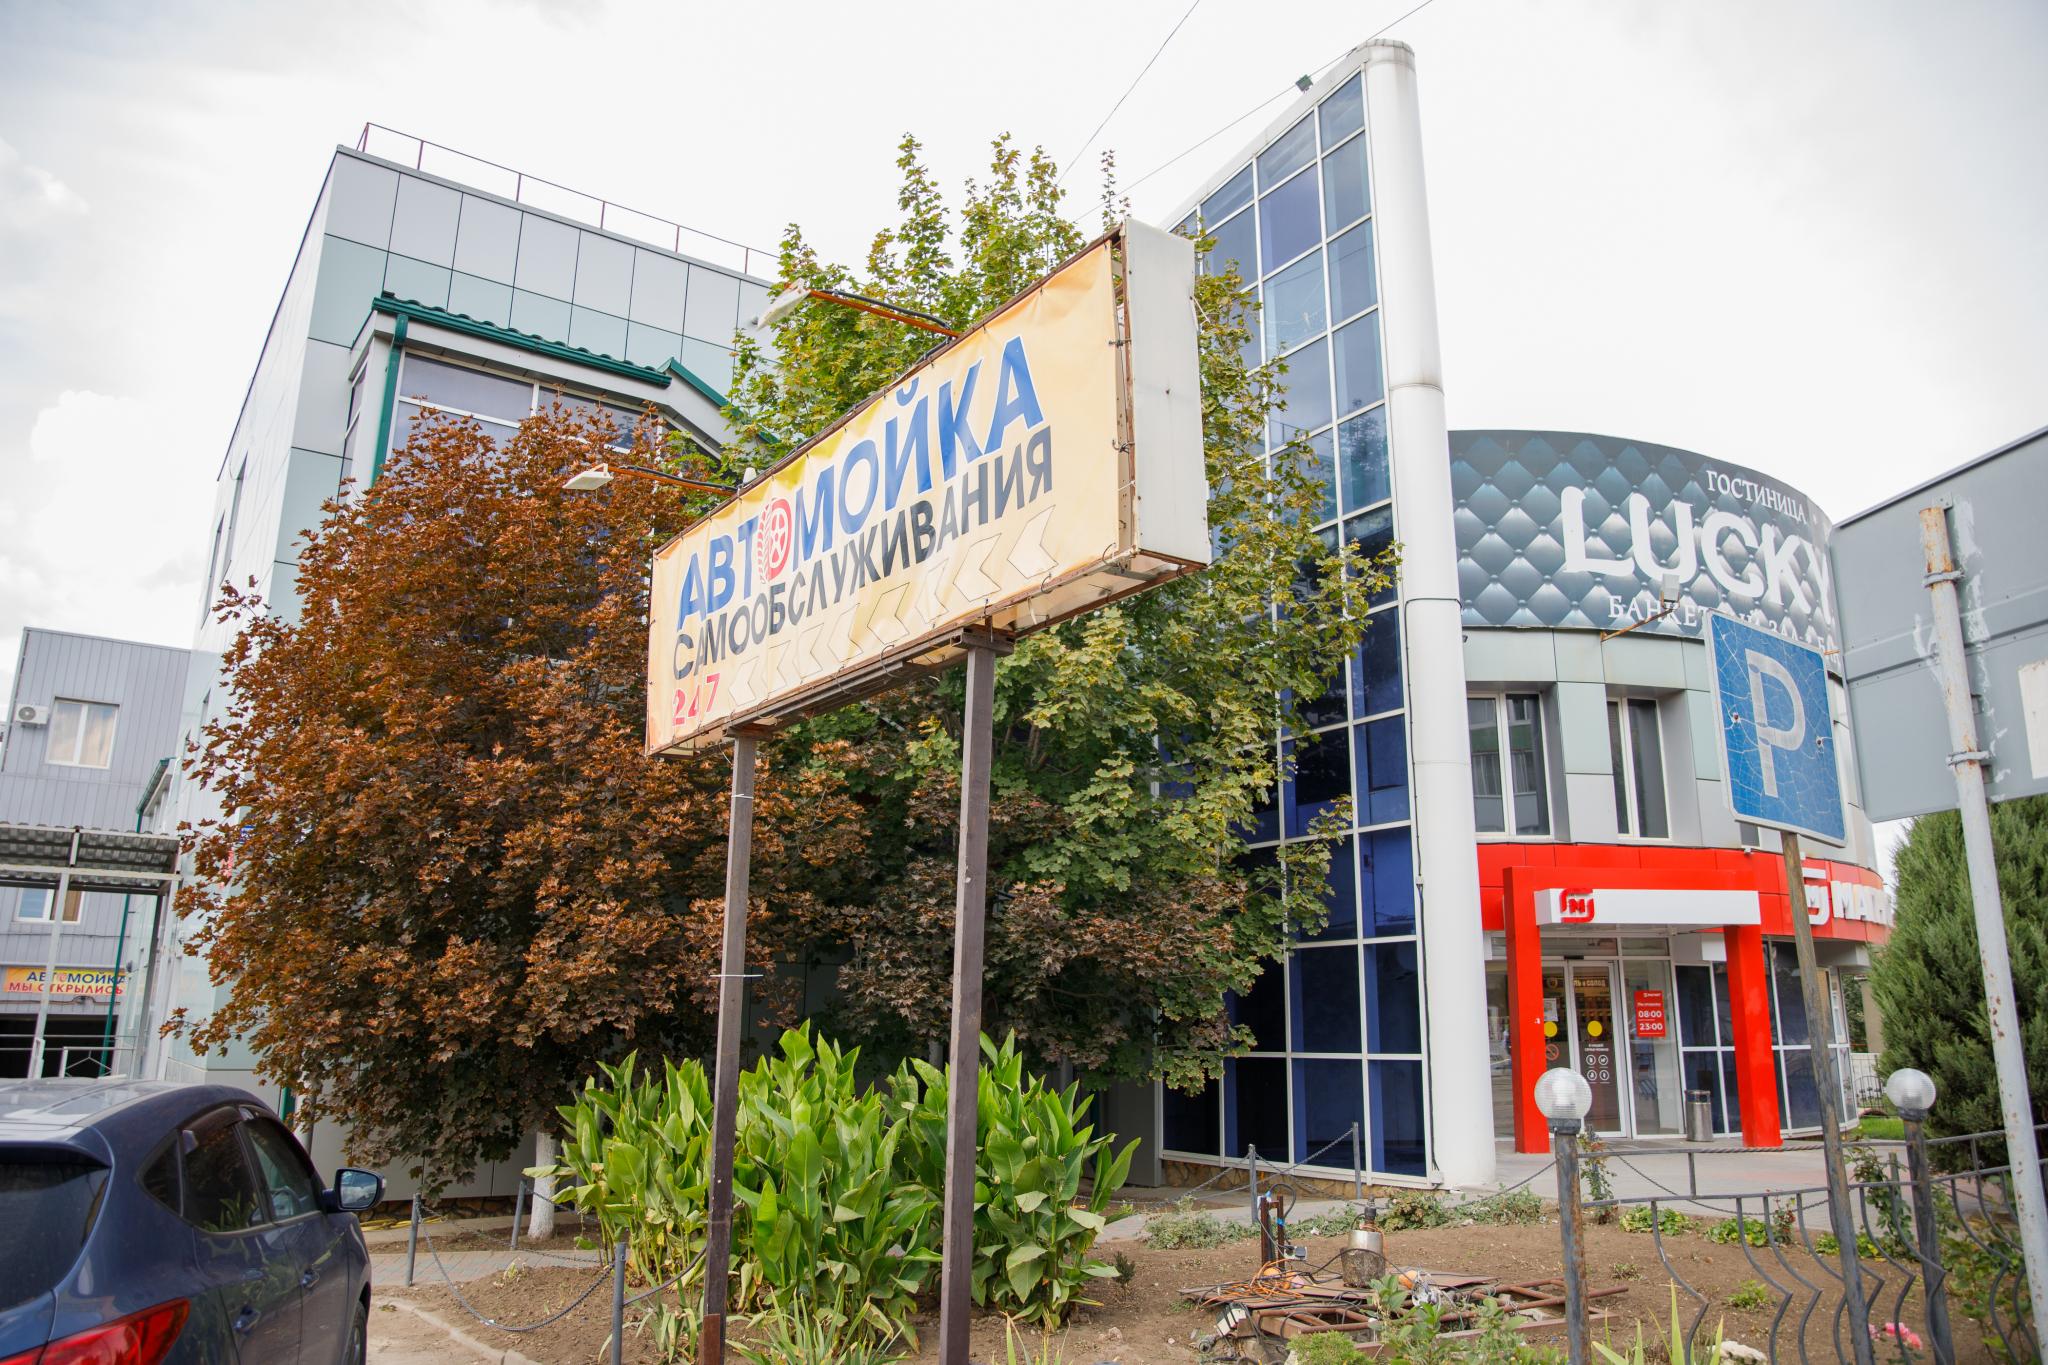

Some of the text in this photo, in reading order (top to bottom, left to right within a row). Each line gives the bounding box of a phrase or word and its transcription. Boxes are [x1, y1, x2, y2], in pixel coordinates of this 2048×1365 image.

[1706, 470, 1808, 525] ГОСТИНИЦА
[673, 425, 1053, 680] САМООБСЛУЖИВАНИЯ
[1561, 486, 1832, 625] LUCKY
[9, 982, 32, 992] МЫ
